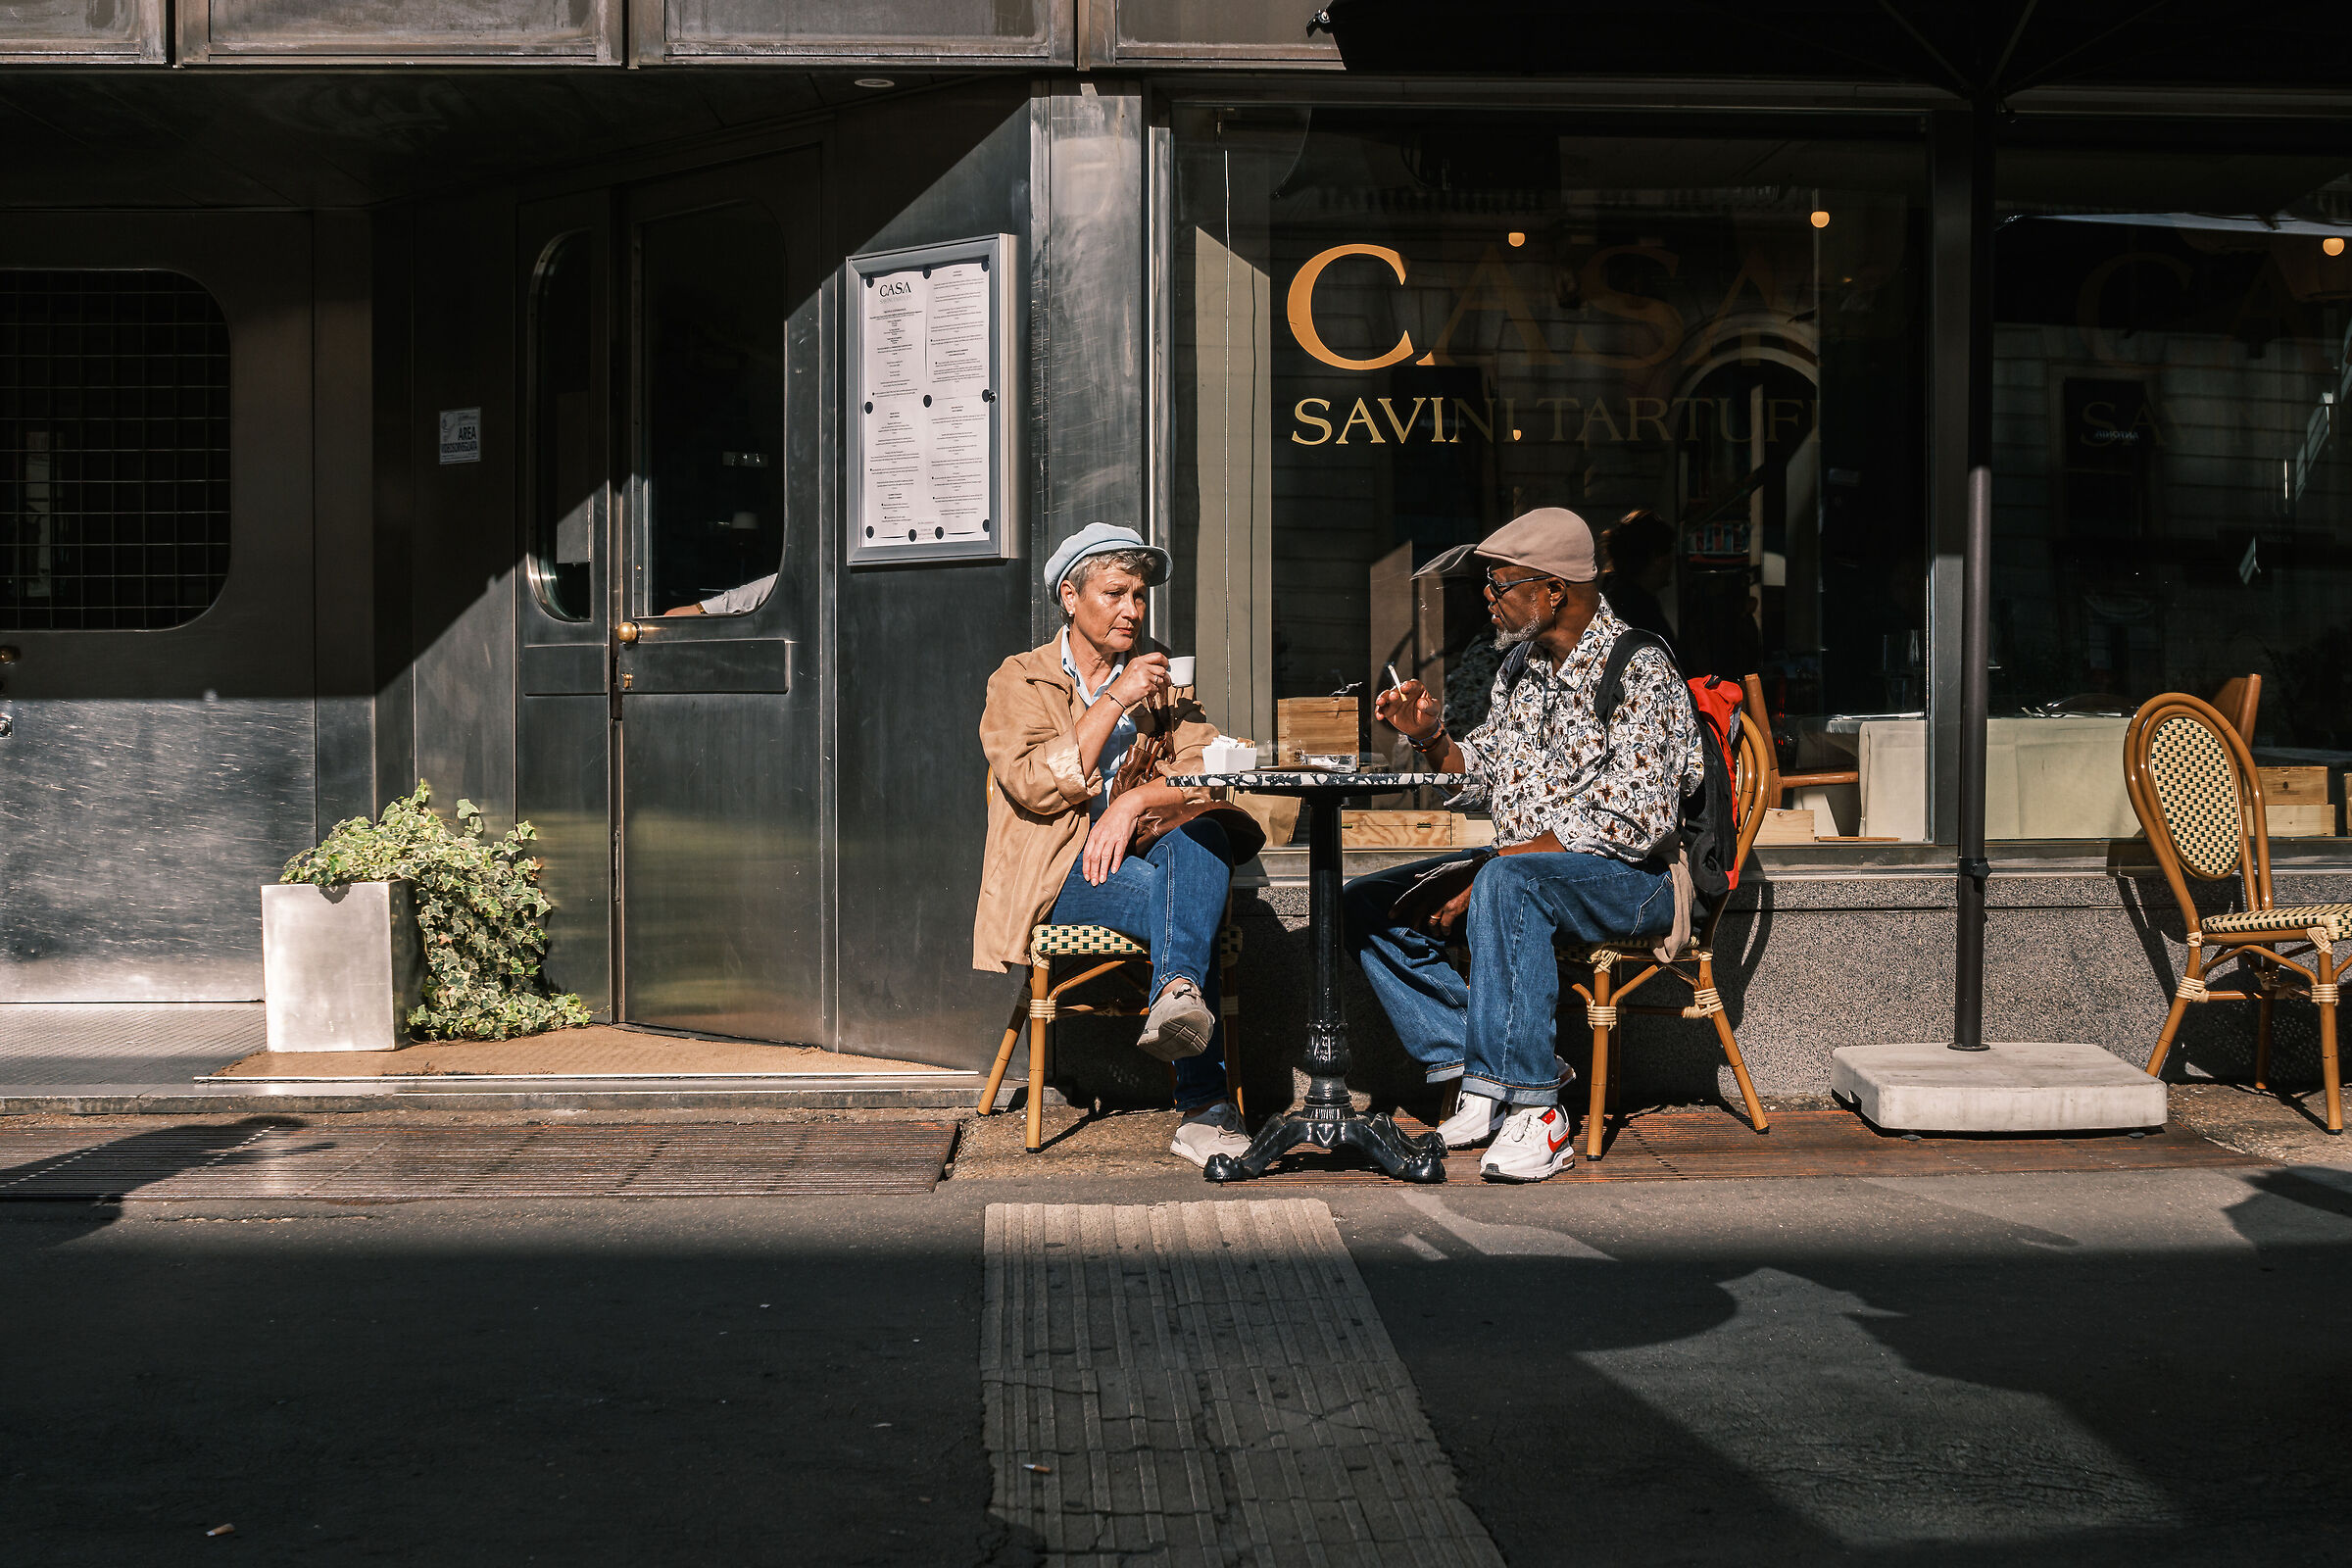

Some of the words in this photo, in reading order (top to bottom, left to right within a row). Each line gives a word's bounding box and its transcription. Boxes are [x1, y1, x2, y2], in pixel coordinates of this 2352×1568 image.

[879, 281, 911, 297] CASA
[1287, 241, 1821, 370] CASA
[458, 426, 476, 440] AREA
[1291, 397, 1515, 447] SAVINI
